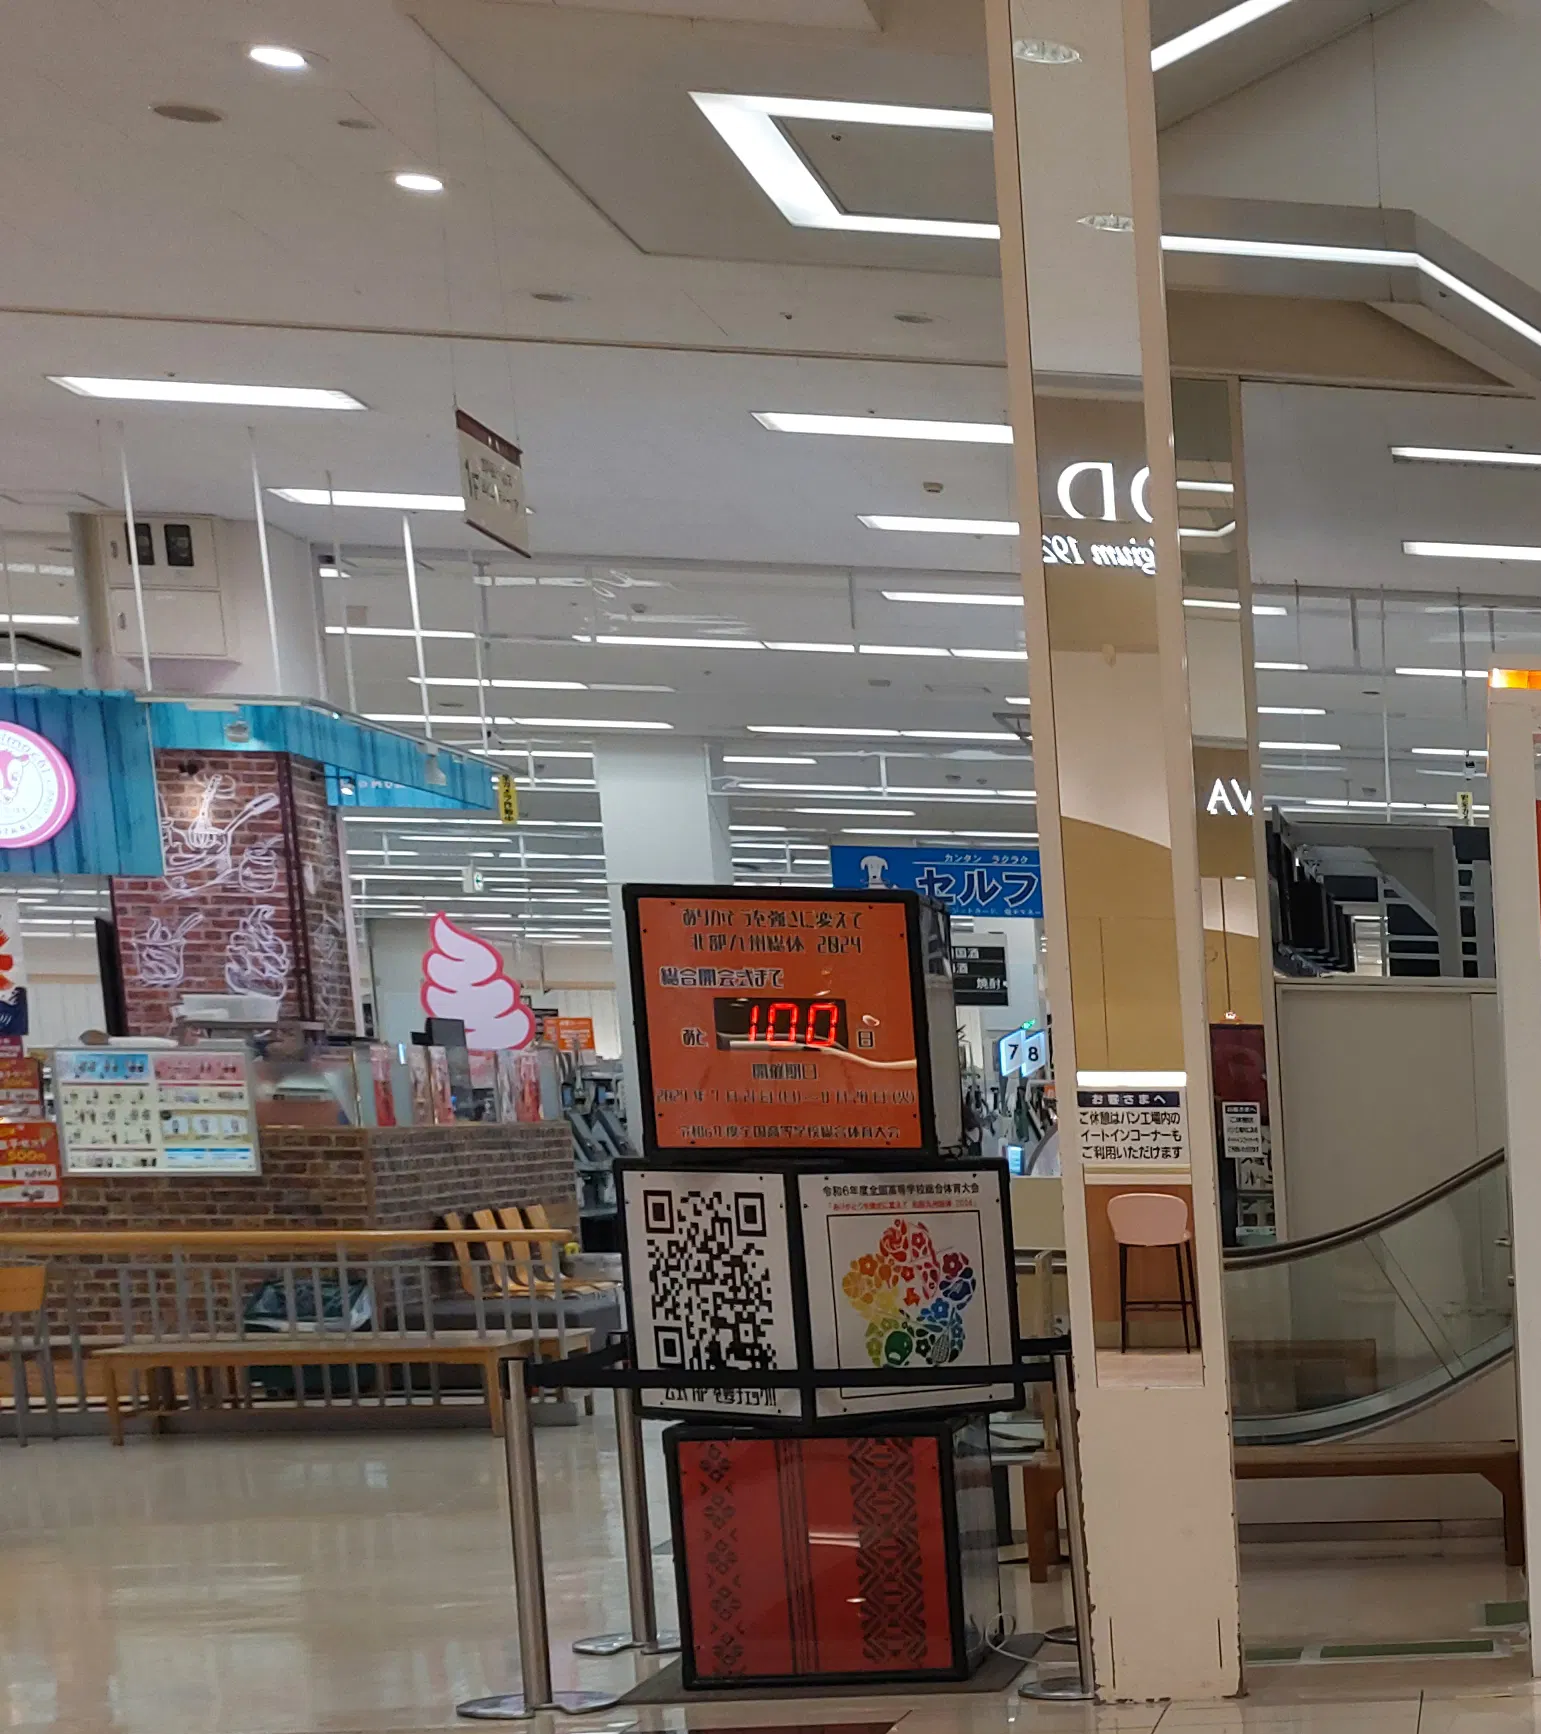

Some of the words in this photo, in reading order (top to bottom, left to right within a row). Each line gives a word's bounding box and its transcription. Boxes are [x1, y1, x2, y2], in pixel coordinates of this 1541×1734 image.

[944, 854, 983, 864] カンタン
[915, 866, 1040, 908] セルフ
[816, 935, 862, 955] 2024
[748, 1001, 840, 1048] 100
[856, 1029, 876, 1049] 日
[1007, 1043, 1019, 1061] 7
[1027, 1044, 1039, 1063] 8
[1079, 1111, 1181, 1127] ご休憩はパン工場内の
[1080, 1128, 1183, 1143] イートインコーナーも
[1081, 1145, 1184, 1160] ご利用いただけます
[822, 1182, 980, 1198] 令和6年度全国高等学校総合体育大会
